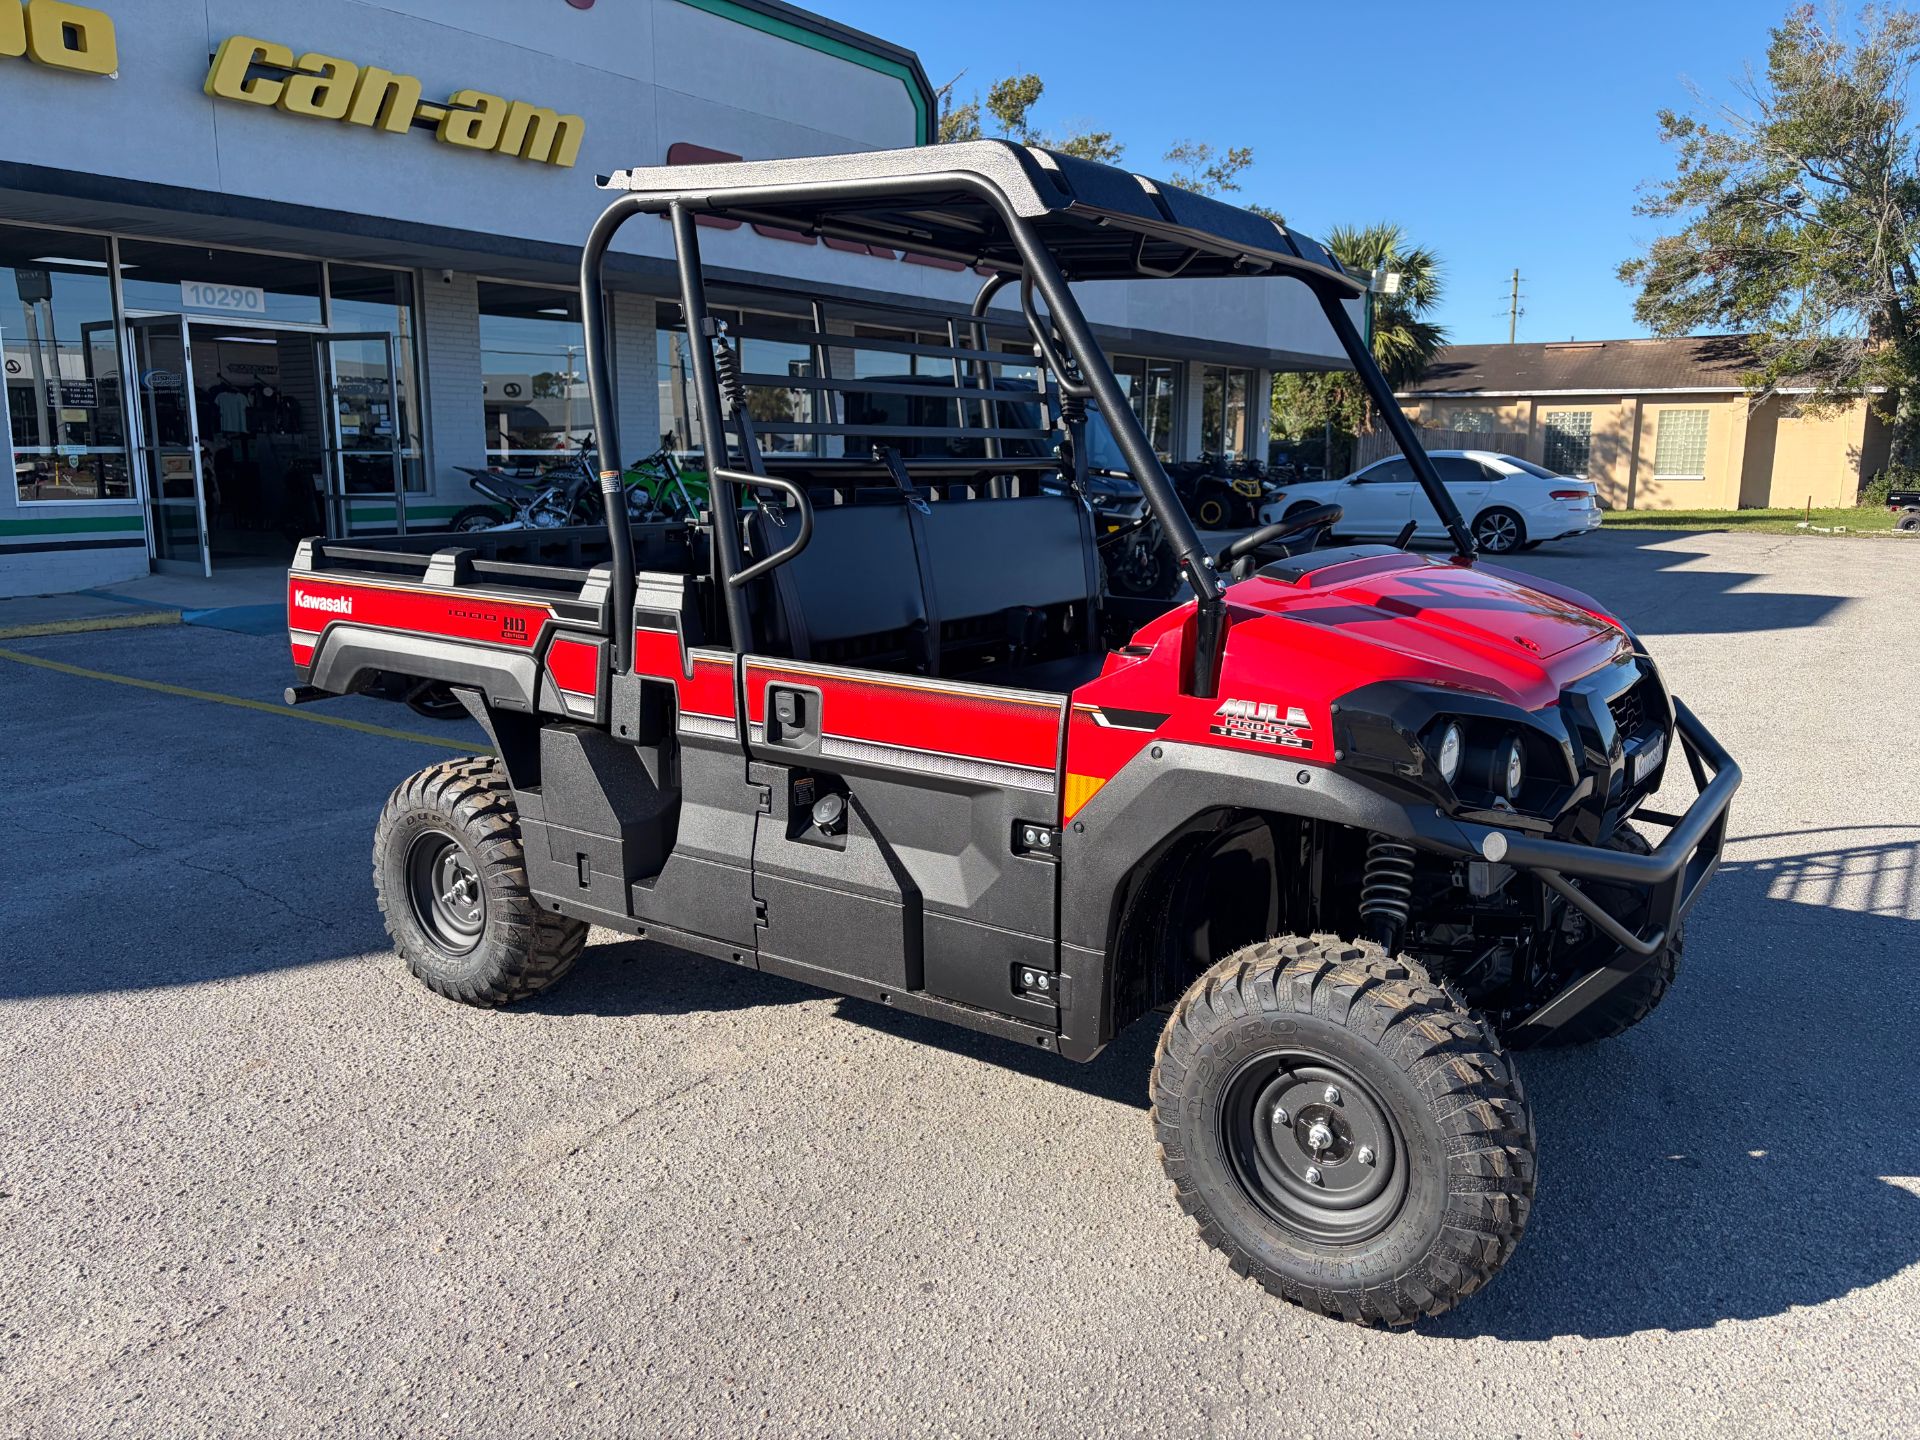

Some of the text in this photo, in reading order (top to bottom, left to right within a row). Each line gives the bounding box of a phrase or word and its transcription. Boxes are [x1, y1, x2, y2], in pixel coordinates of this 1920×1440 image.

[0, 0, 118, 77] o
[189, 284, 258, 309] 10290
[294, 589, 353, 615] Kawasaki
[503, 616, 526, 632] HD
[1213, 697, 1313, 730] MULE
[1195, 1016, 1298, 1088] DURO
